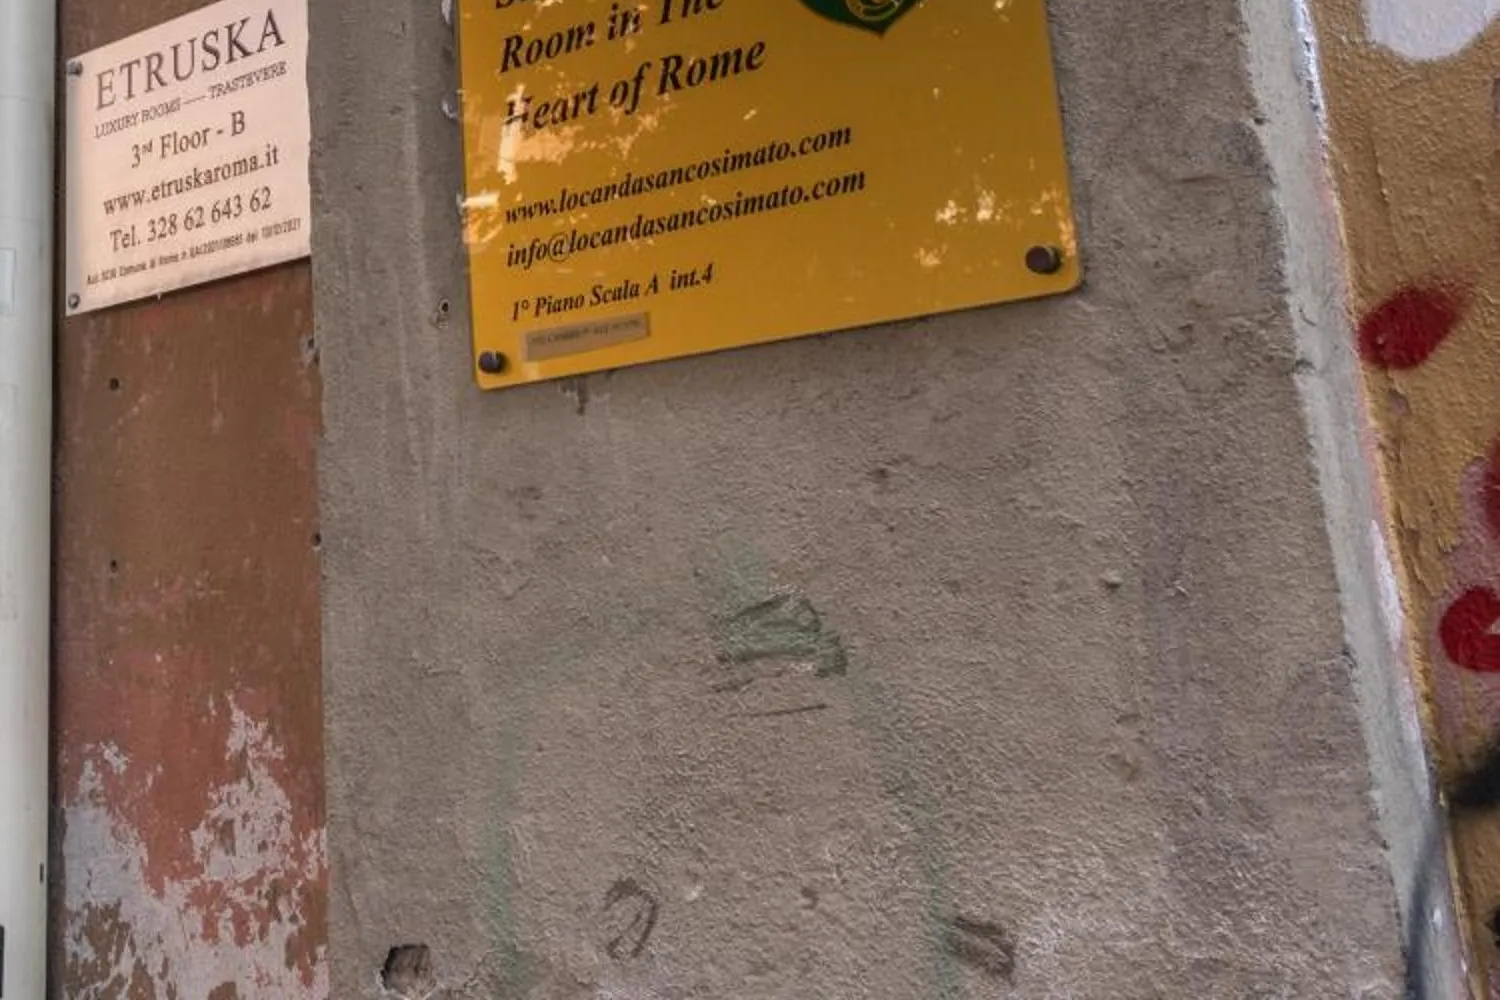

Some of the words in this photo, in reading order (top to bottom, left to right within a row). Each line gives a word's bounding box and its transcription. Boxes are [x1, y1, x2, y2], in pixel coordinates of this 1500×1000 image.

[95, 8, 286, 112] ETRUSKA
[499, 20, 596, 74] Room
[607, 1, 642, 41] in
[94, 111, 141, 140] LUXURY
[142, 97, 182, 123] ROOMS
[209, 60, 288, 101] TRASTEVERE
[609, 61, 652, 115] of
[656, 39, 766, 96] Rome
[131, 138, 154, 169] 3rd
[160, 126, 211, 163] Floor
[231, 110, 247, 137] B
[505, 125, 853, 226] www.locandasancosimato.com
[103, 143, 280, 217] www.etruskaroma.it
[109, 228, 142, 254] Tel.
[148, 212, 179, 241] 328
[183, 205, 206, 231] 62
[211, 193, 244, 225] 643
[249, 185, 273, 214] 62
[506, 169, 866, 271] info@locandasancosimato.com
[533, 289, 586, 319] Piano
[589, 278, 640, 307] Scala
[643, 272, 660, 296] A
[670, 262, 715, 292] int.4
